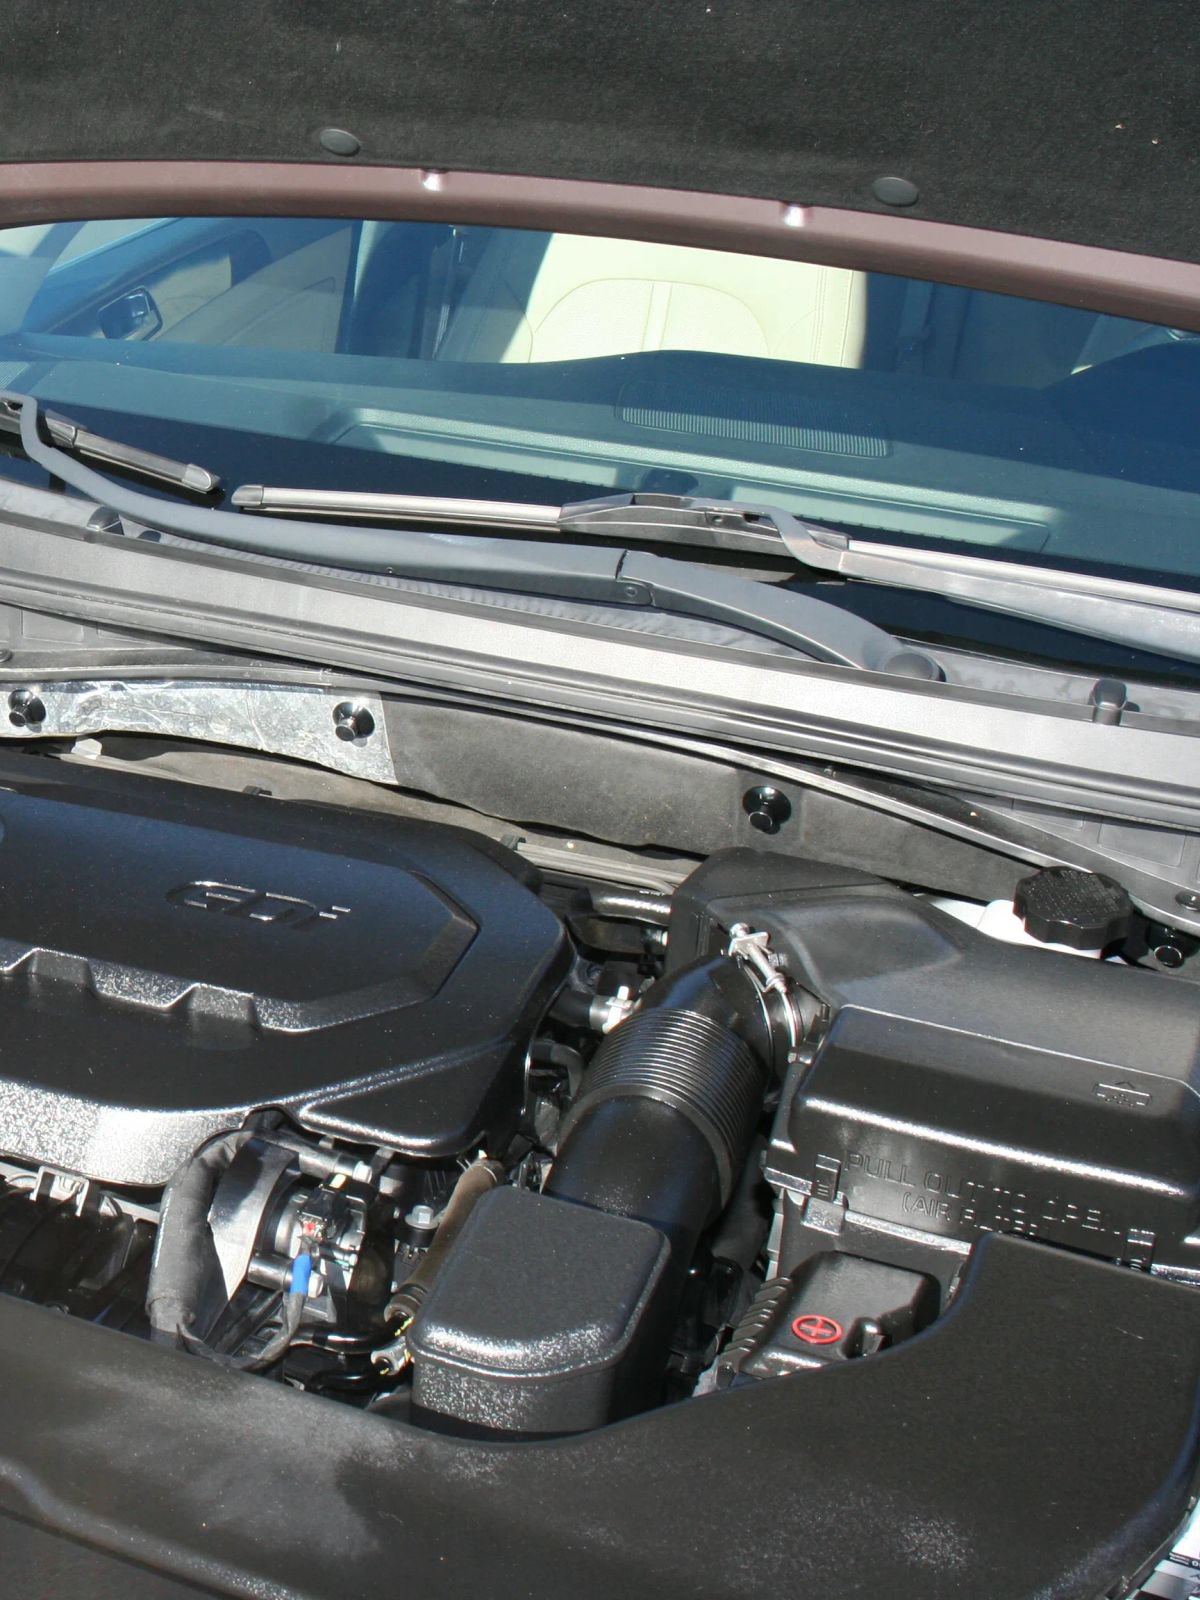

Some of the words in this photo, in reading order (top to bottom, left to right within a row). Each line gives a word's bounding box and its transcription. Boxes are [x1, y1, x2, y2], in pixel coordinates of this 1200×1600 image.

[844, 1151, 916, 1188] PULL
[923, 1170, 985, 1203] OUT
[992, 1186, 1028, 1215] TO
[903, 1191, 951, 1221] (AIR
